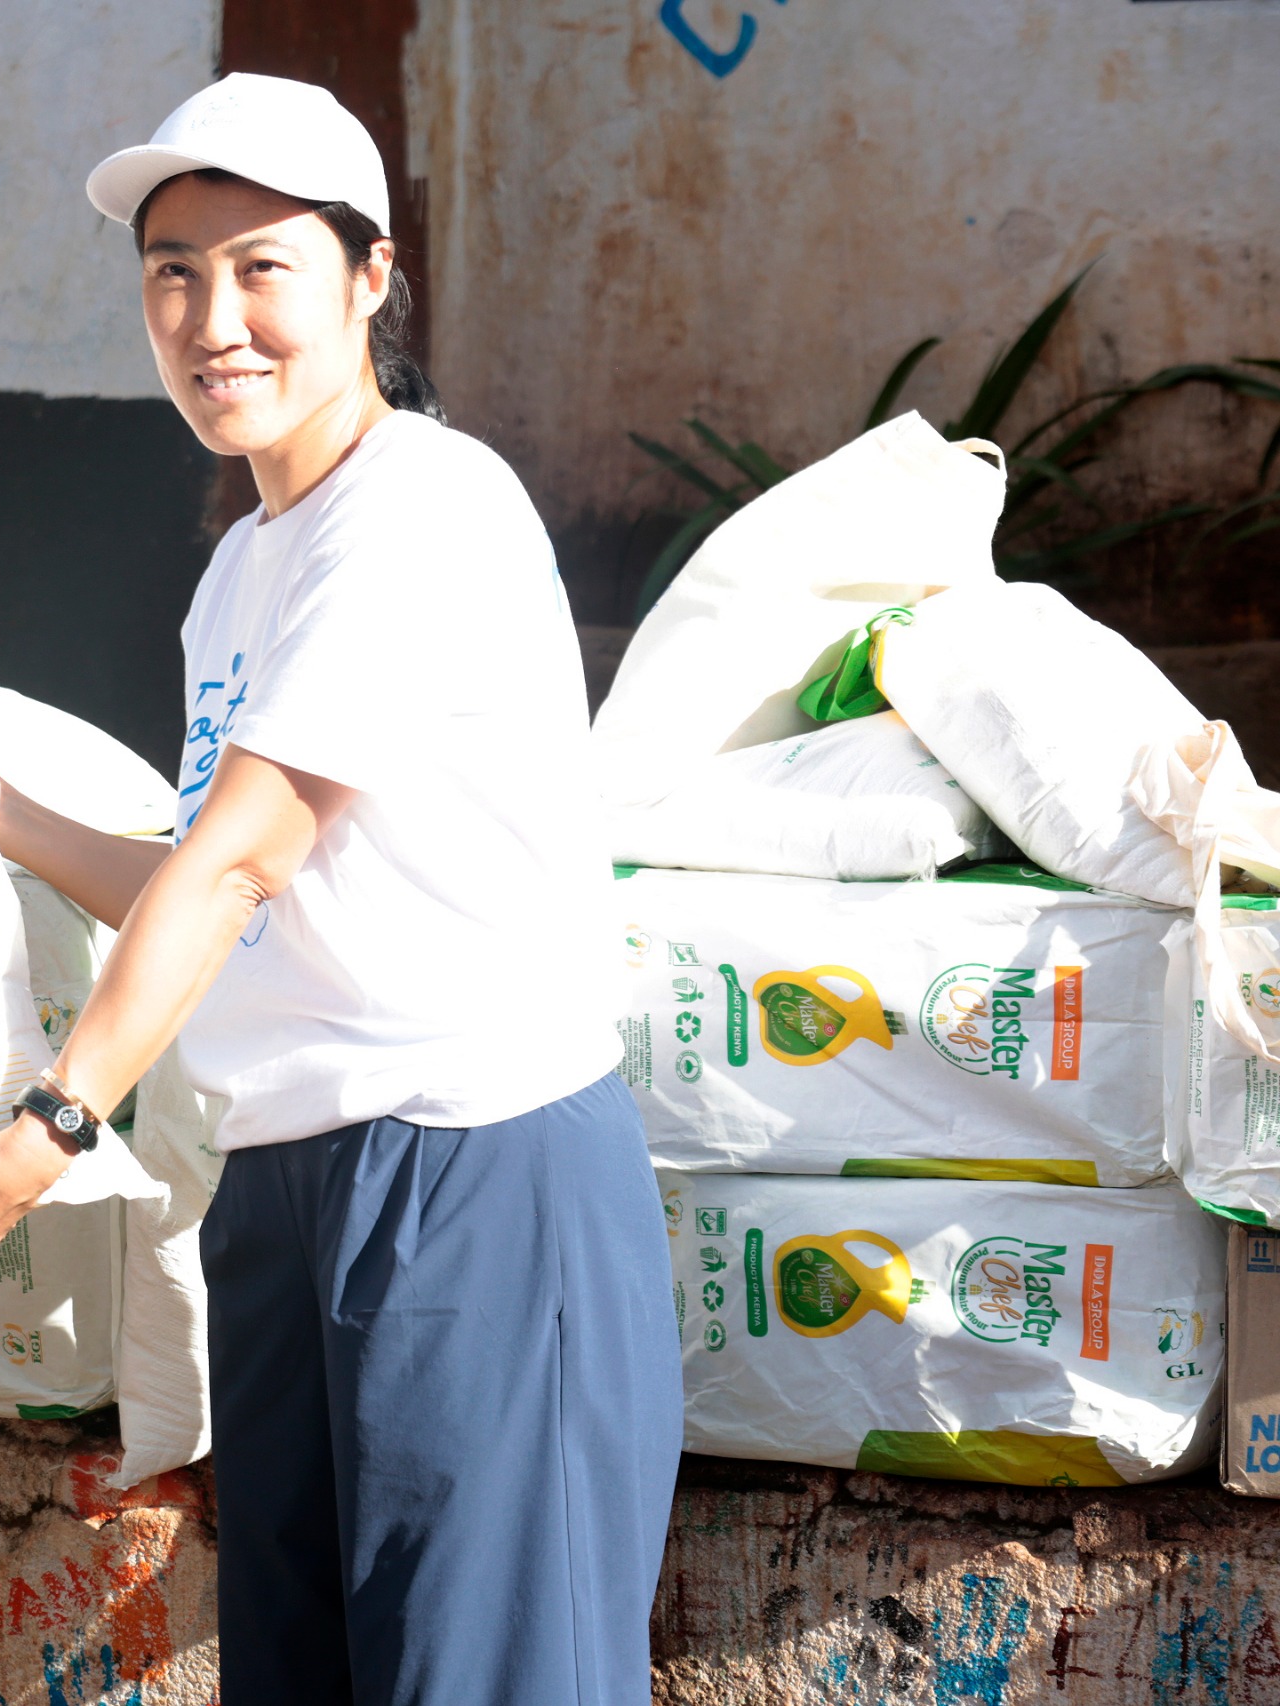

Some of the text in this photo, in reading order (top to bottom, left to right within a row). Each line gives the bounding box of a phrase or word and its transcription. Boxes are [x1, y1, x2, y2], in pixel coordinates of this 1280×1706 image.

[644, 1013, 652, 1092] MANUFACTURED BY:
[734, 1012, 742, 1025] OF
[734, 1026, 742, 1056] KENYA
[795, 995, 819, 1046] Master
[926, 974, 962, 1064] Premium Maize Flour
[947, 985, 992, 1055] Chef
[991, 967, 1037, 1080] Master
[1194, 1019, 1204, 1118] PAPERPLAST
[750, 1238, 762, 1326] PRODUCT OF KENYA
[796, 1268, 821, 1308] Chef
[814, 1262, 836, 1317] Master
[958, 1246, 990, 1330] Premium Maize Flour
[978, 1258, 1024, 1322] Chef
[1021, 1241, 1067, 1348] Master
[31, 1330, 42, 1364] EGL
